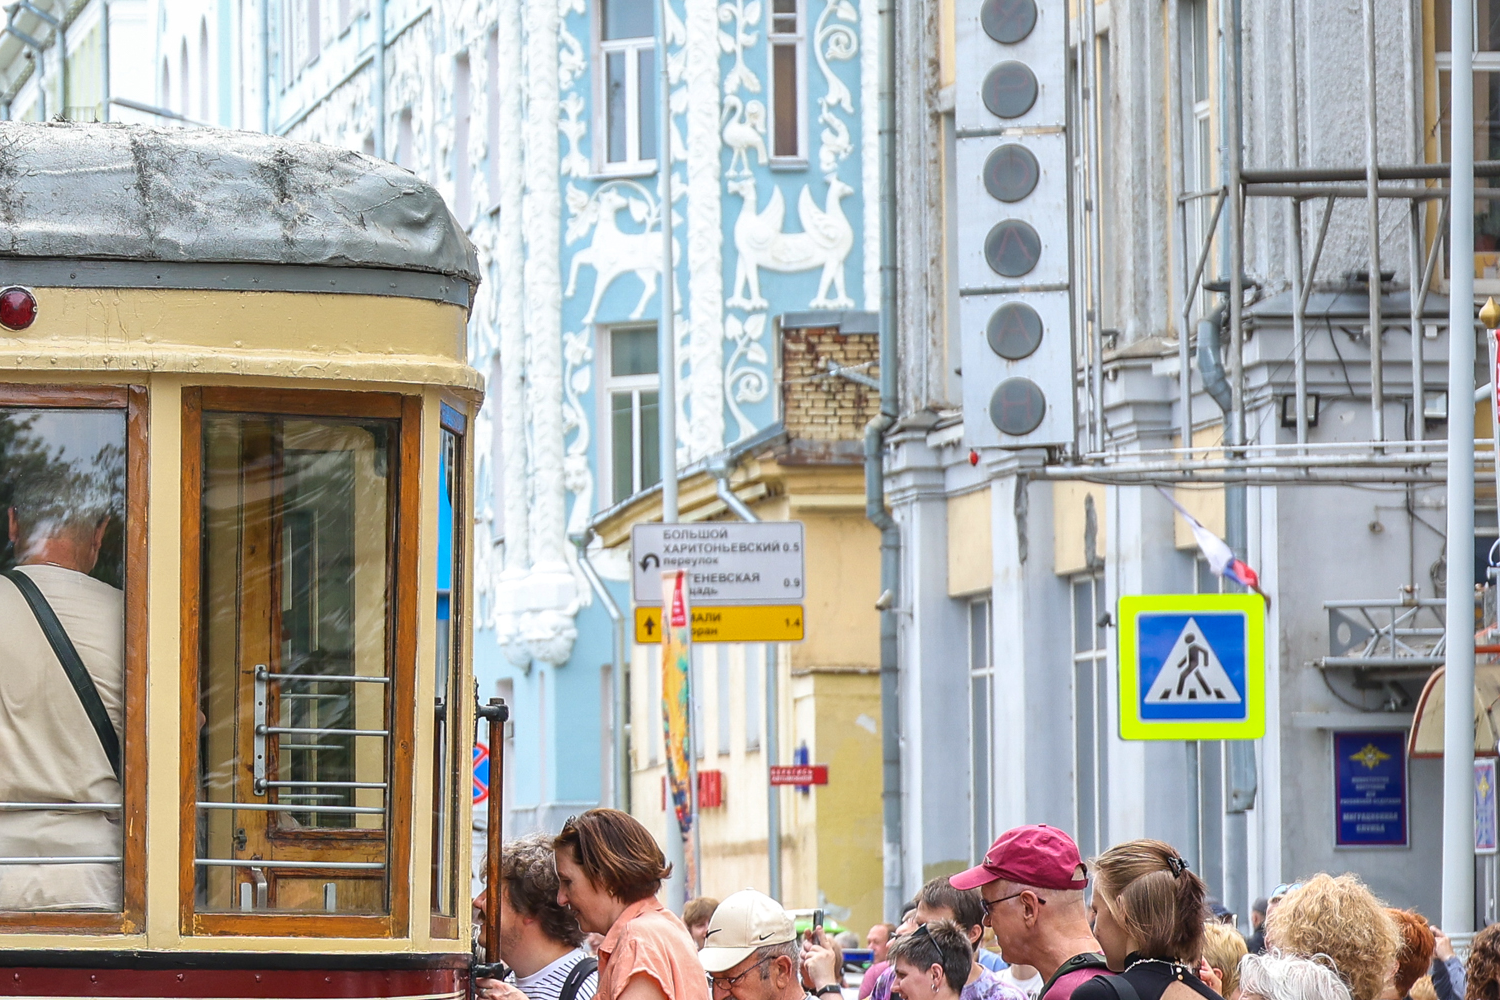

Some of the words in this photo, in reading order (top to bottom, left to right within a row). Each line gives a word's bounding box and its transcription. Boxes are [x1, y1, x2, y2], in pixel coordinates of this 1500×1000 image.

[663, 528, 728, 539] БОЛЬШОЙ
[663, 541, 780, 553] ХАРИТОНЬЕВСКИЙ
[782, 542, 800, 552] 0.5
[663, 557, 719, 567] переулок
[783, 578, 801, 588] 0.9
[785, 618, 800, 627] 1.4
